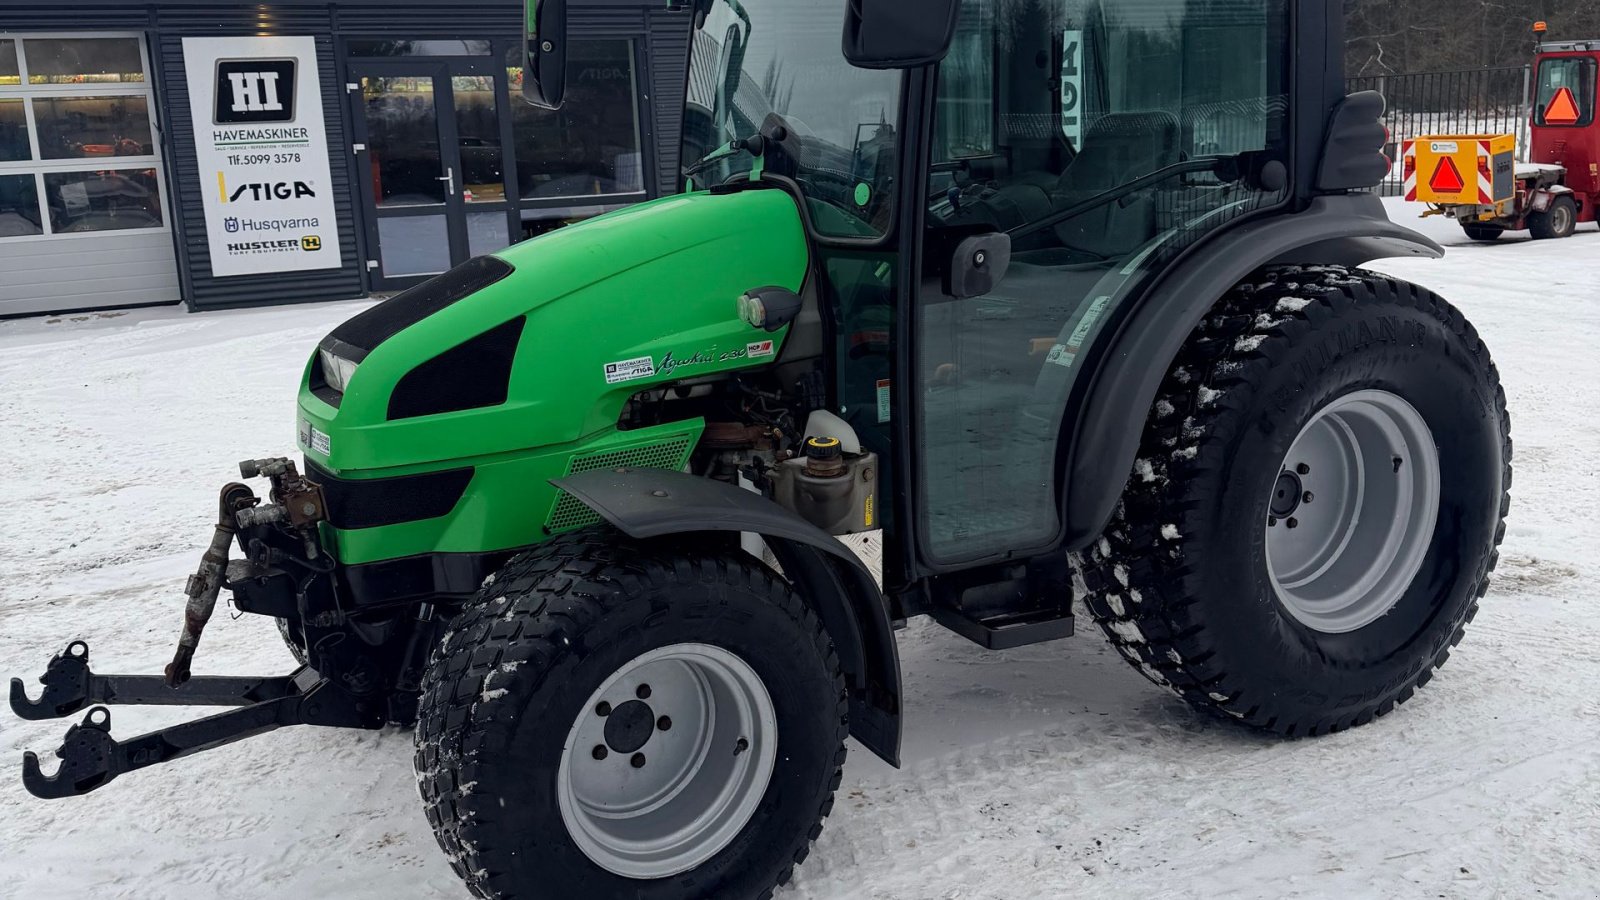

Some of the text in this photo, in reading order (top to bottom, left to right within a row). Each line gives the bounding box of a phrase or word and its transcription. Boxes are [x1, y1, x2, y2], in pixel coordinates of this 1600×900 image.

[227, 71, 283, 112] HI
[213, 127, 309, 141] HAVEMASKINER
[274, 153, 301, 163] 3578
[229, 181, 316, 202] STIGA
[242, 217, 319, 232] Husqvarna
[227, 239, 299, 251] HUSTLER
[631, 366, 653, 375] STIGA
